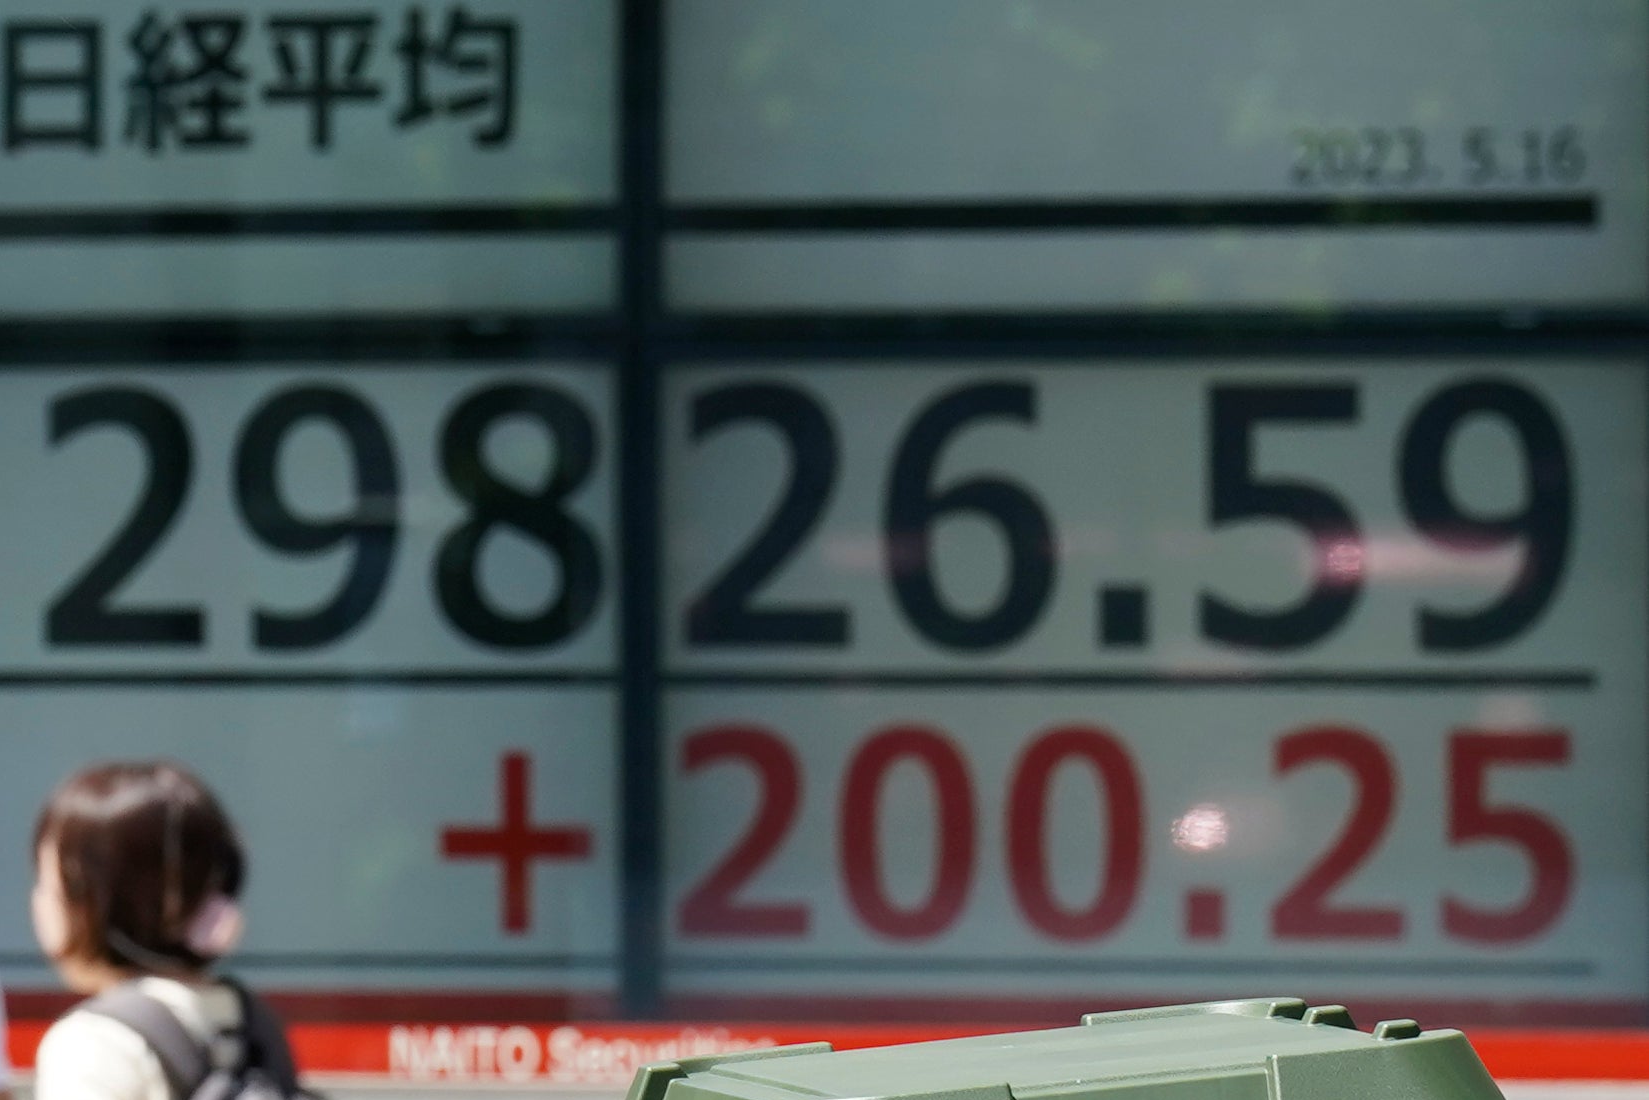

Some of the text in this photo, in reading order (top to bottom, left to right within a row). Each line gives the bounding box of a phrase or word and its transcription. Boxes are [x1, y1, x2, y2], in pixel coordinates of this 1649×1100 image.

[0, 10, 517, 152] 日経平均
[387, 1024, 543, 1081] NAITO
